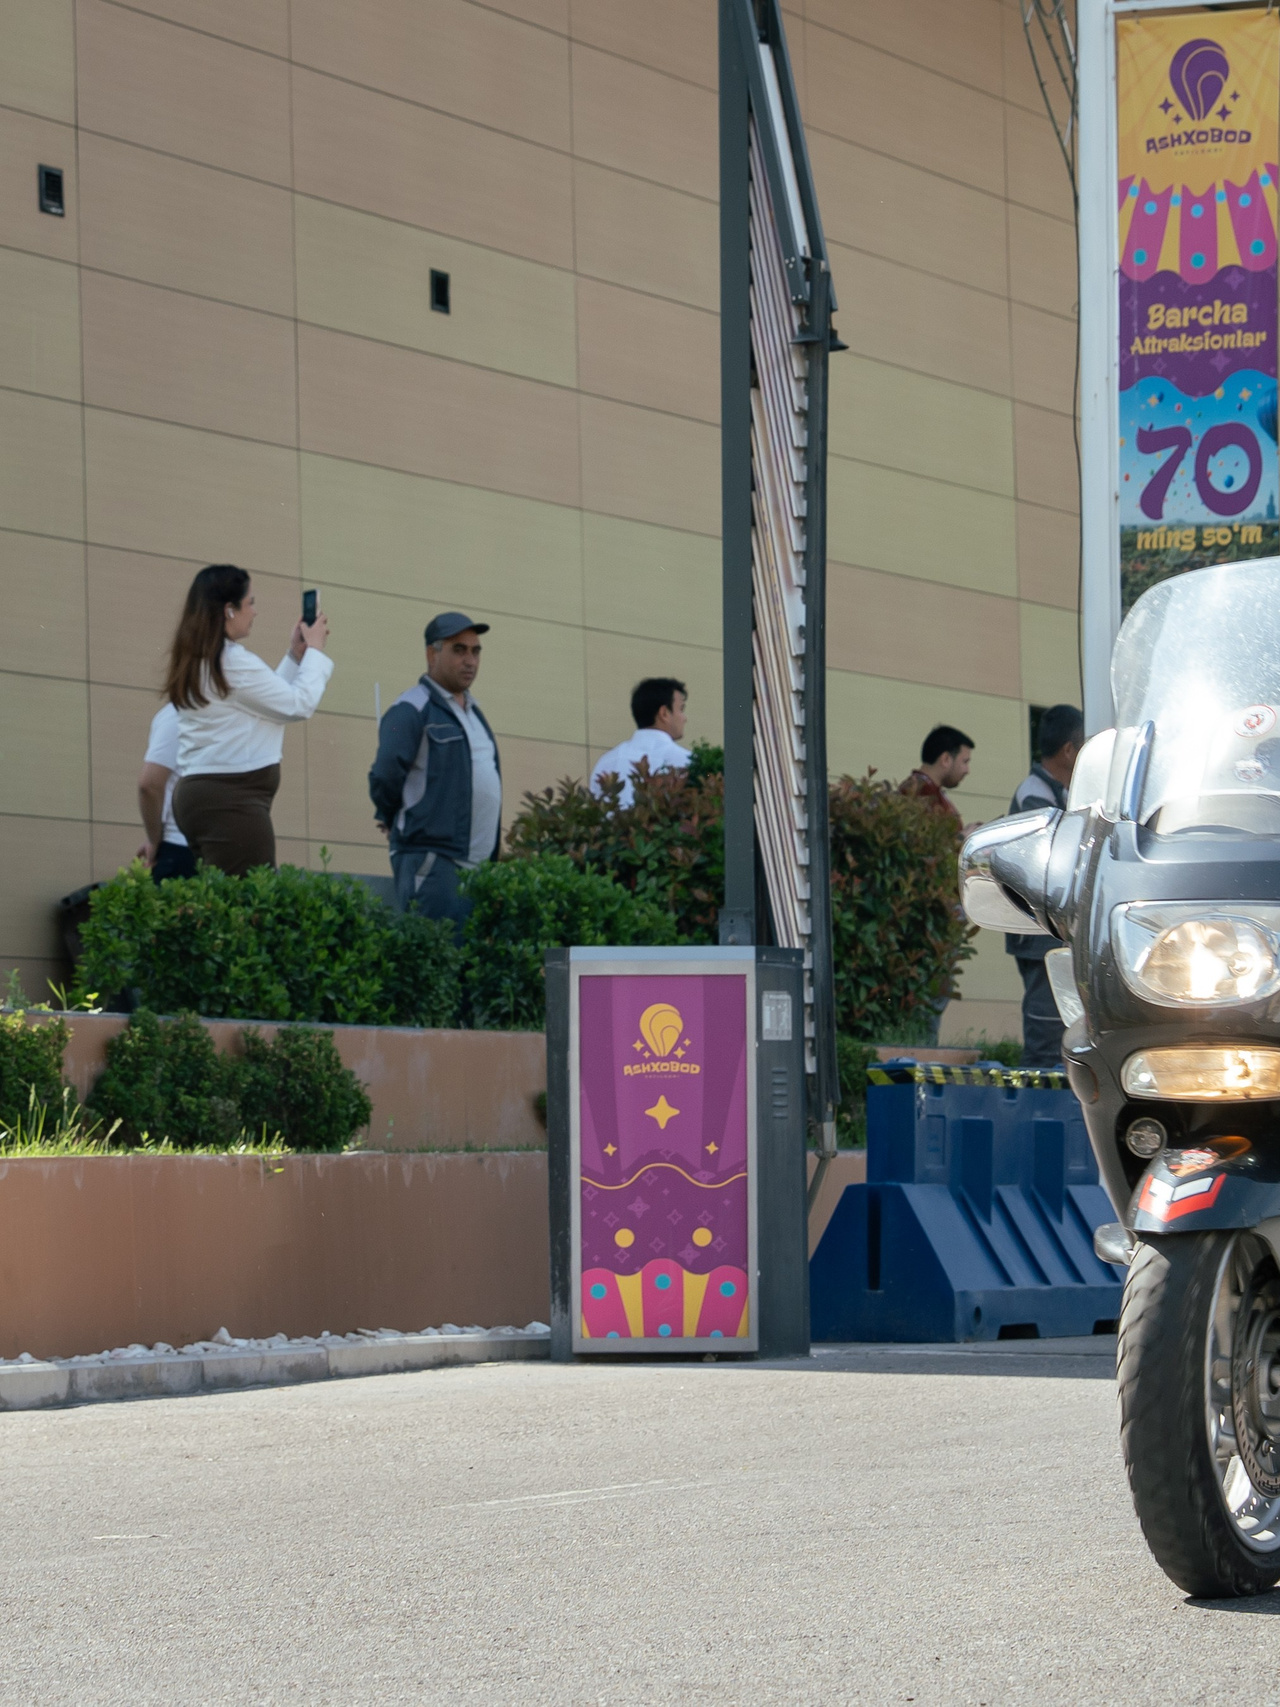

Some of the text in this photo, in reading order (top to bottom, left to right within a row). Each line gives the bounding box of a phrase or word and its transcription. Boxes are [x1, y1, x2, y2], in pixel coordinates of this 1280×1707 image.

[1146, 128, 1252, 154] ASHXOBOD
[1147, 299, 1248, 330] Barcha
[1130, 329, 1268, 356] Attraksionlar
[1136, 421, 1264, 520] 70
[1136, 525, 1197, 551] ming
[623, 1061, 701, 1076] ASHXOBOD
